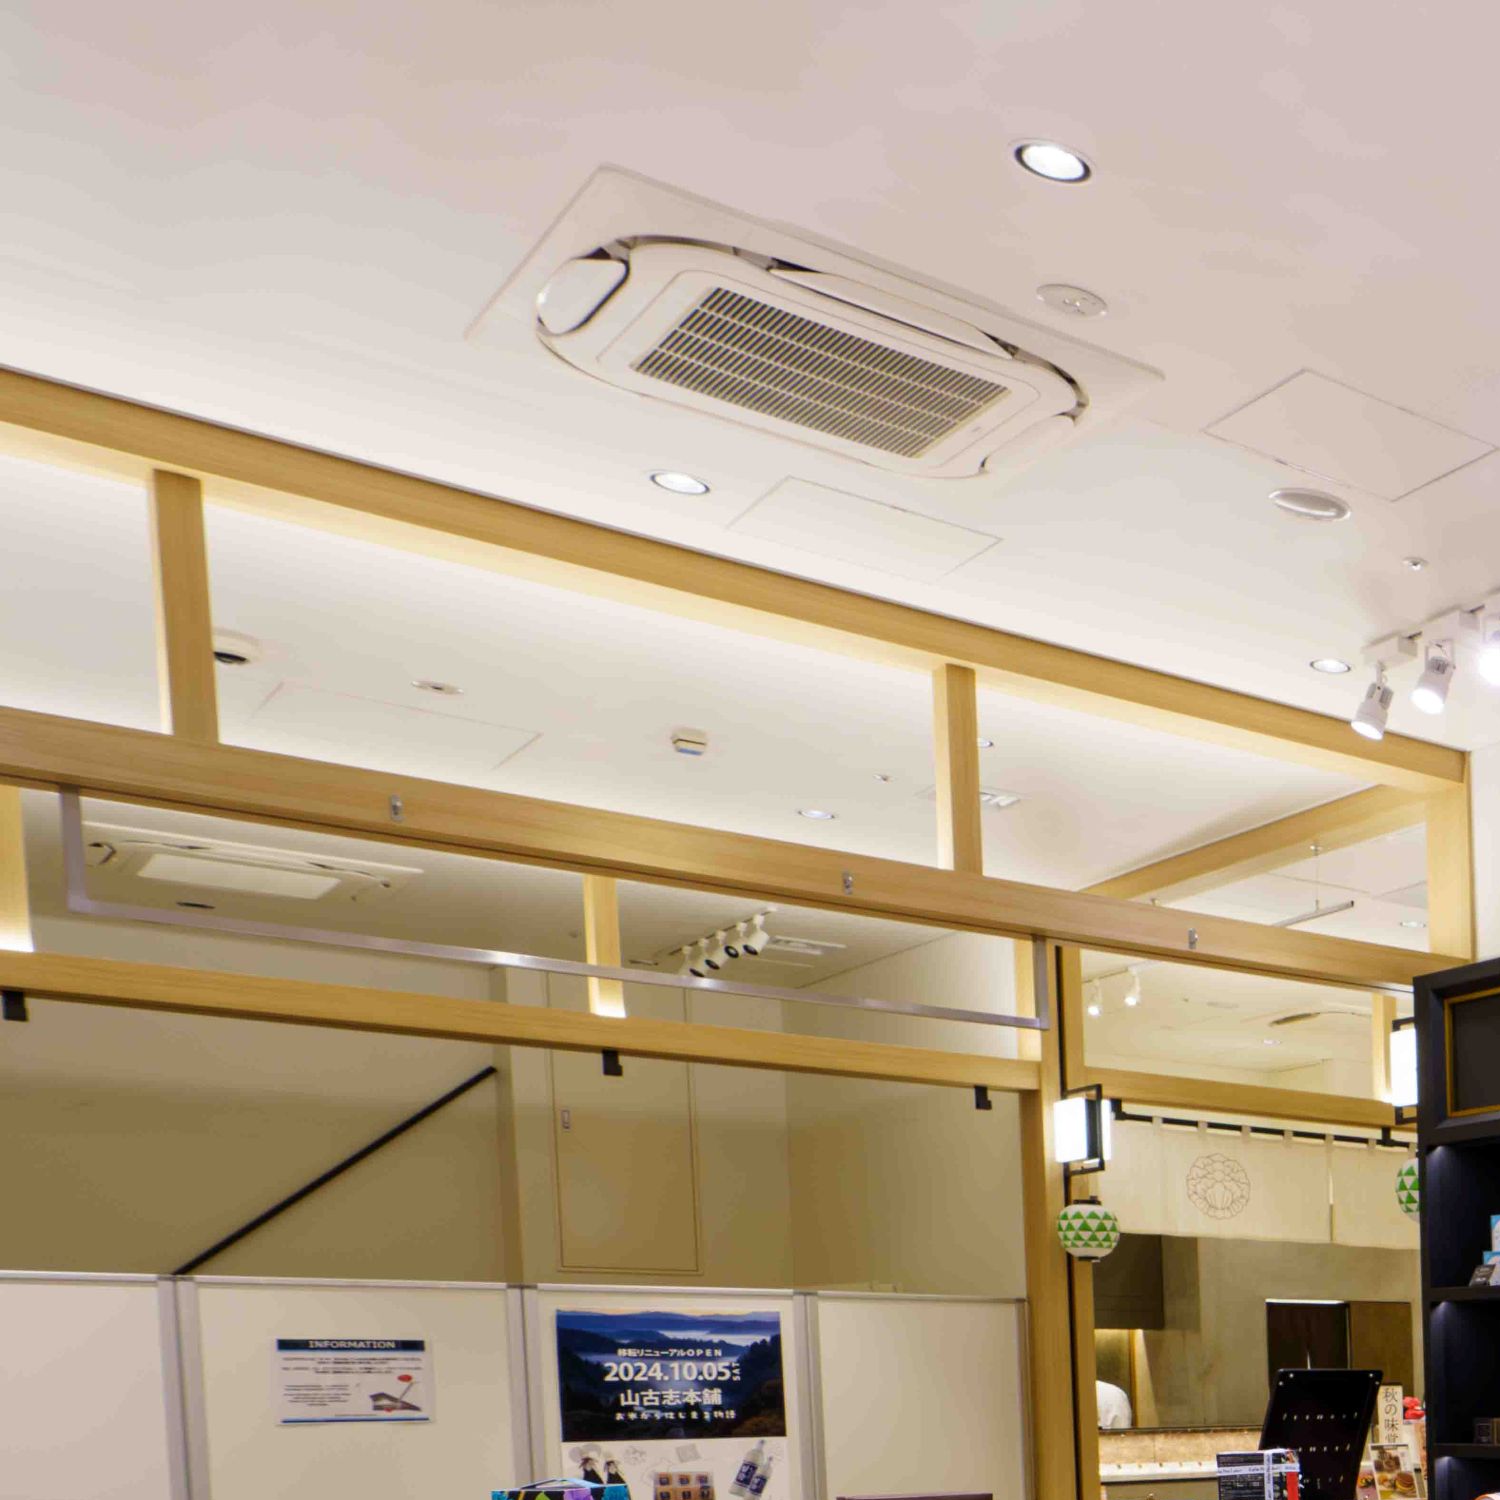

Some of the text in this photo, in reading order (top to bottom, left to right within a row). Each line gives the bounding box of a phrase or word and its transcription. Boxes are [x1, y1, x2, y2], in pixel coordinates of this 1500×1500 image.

[308, 1340, 395, 1349] INFORMATION
[603, 1361, 741, 1382] 2024.10.05 SAT
[620, 1387, 723, 1407] 山古志本舗
